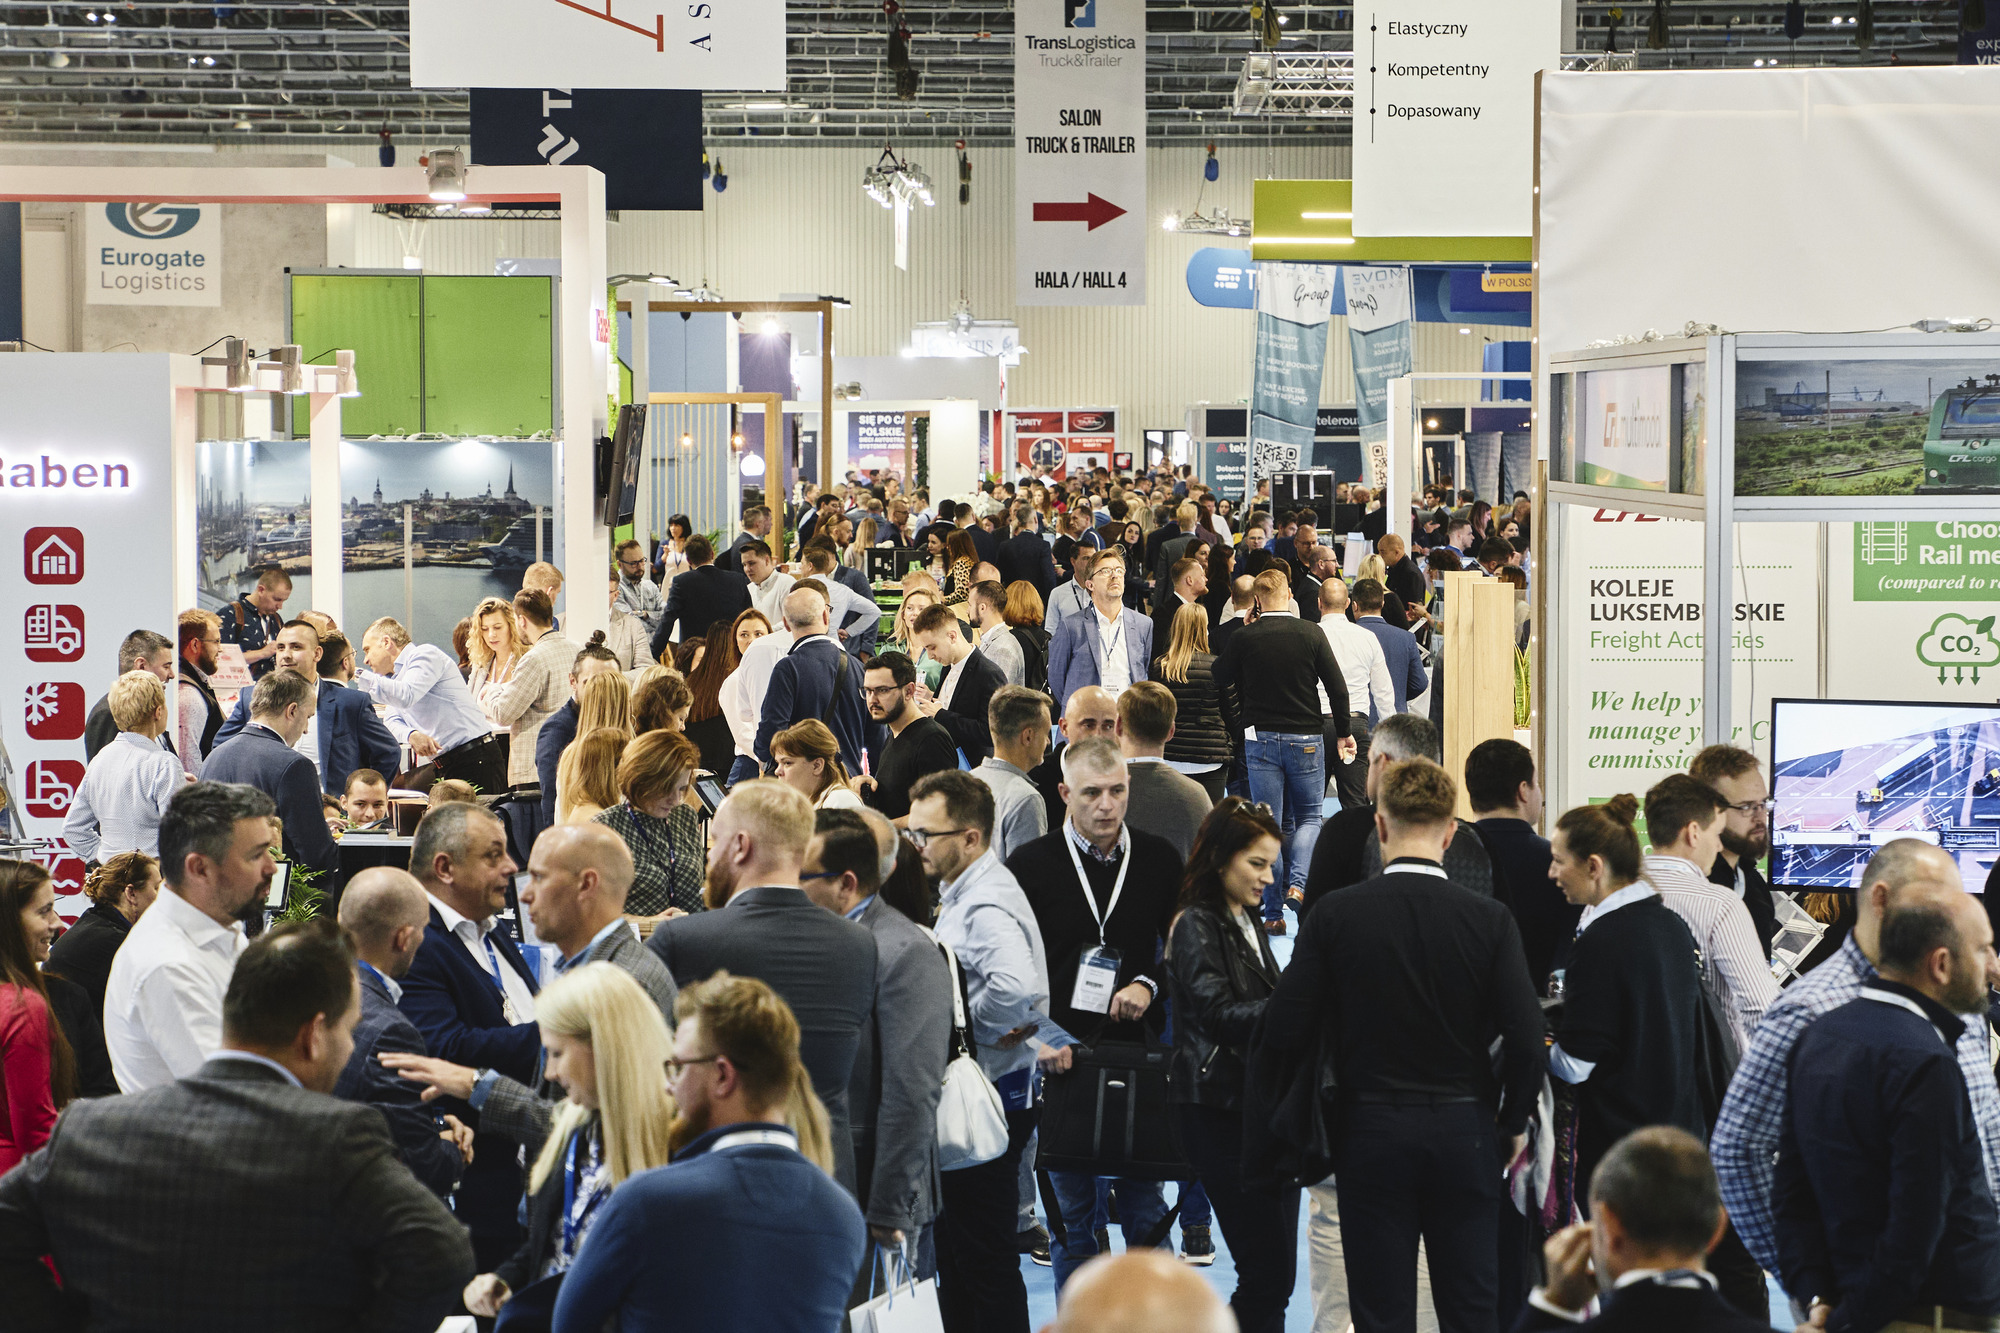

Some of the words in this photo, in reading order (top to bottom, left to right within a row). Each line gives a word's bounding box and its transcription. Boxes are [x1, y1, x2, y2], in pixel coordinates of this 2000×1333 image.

[1388, 21, 1468, 38] Elastyczny
[1025, 35, 1136, 53] TransLogistica
[1039, 53, 1122, 67] Truck&Trailer
[1388, 63, 1490, 79] Kompetentny
[1059, 109, 1102, 126] SALON
[1387, 104, 1481, 120] Dopasowany
[1026, 136, 1068, 154] TRUCK
[1071, 136, 1081, 154] &
[1083, 136, 1136, 154] TRAILER
[101, 247, 206, 271] Eurogate
[101, 271, 206, 295] Logistics
[1035, 271, 1069, 289] HALA
[1071, 271, 1080, 289] /
[1082, 271, 1115, 289] HALL
[1117, 271, 1127, 289] 4
[1293, 284, 1330, 308] Group
[877, 415, 892, 425] PO
[1949, 454, 1971, 463] CFL
[1972, 455, 1998, 464] cargo
[0, 455, 129, 488] aben
[1919, 544, 1963, 565] Rail
[1590, 579, 1674, 597] KOLEJE
[1878, 574, 1965, 594] (compared
[1968, 576, 1986, 590] to
[1591, 630, 1662, 652] Freight
[1591, 690, 1625, 712] We
[1631, 690, 1682, 717] help
[1588, 725, 1682, 746] manage
